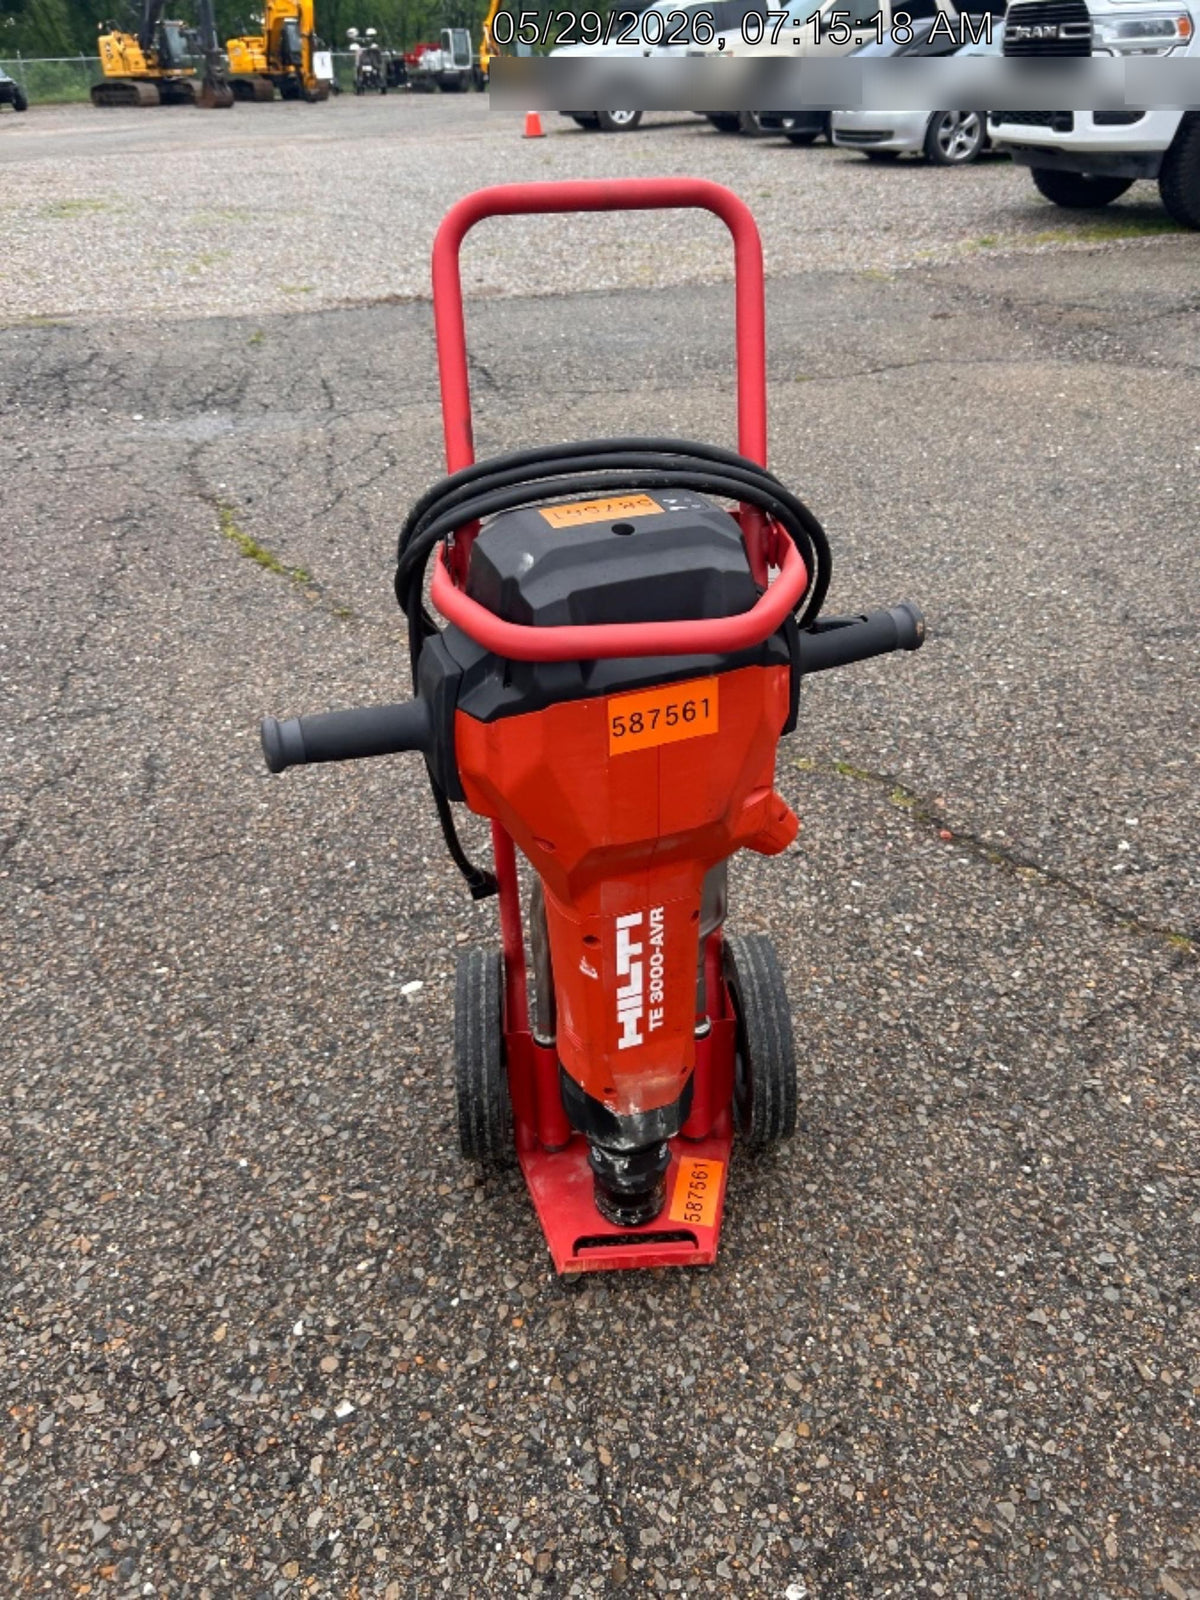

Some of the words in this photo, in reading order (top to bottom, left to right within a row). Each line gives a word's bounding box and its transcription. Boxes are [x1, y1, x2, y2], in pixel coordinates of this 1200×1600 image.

[1018, 26, 1057, 38] RAM
[612, 698, 709, 737] 587561
[650, 906, 664, 1004] 3000-AVR
[616, 912, 643, 1050] HILTI
[649, 1007, 664, 1032] TE
[684, 1163, 708, 1222] 587561
